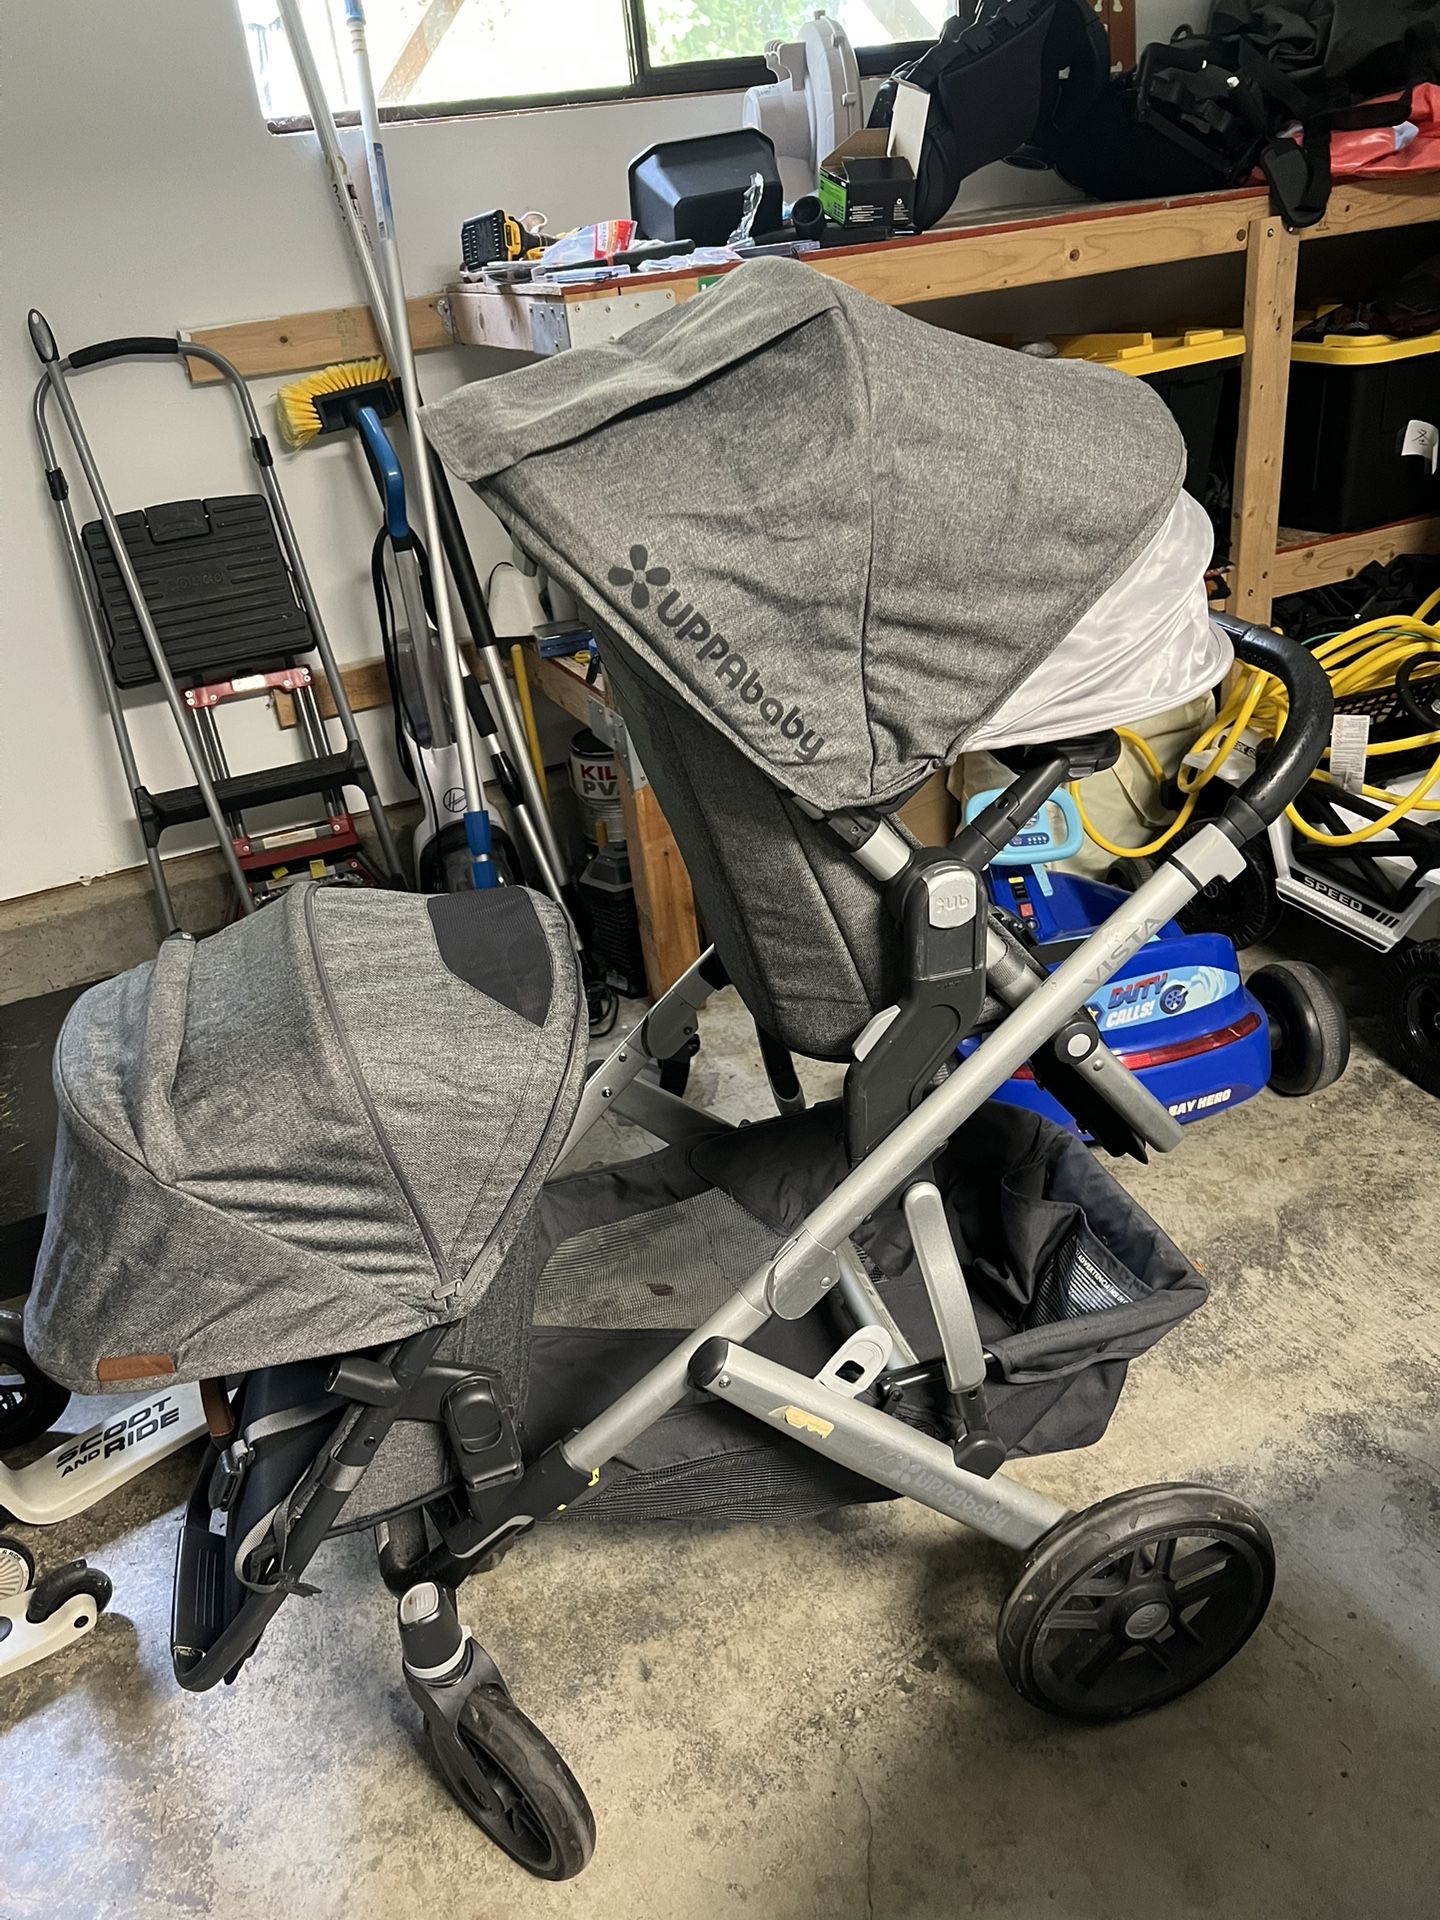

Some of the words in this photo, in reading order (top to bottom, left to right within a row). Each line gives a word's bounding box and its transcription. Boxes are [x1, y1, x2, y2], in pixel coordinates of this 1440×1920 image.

[657, 590, 825, 761] UPPAbaby
[1303, 876, 1363, 912] SPEED
[1082, 917, 1163, 986] VISTA
[1105, 1000, 1156, 1028] CALLS!
[1108, 972, 1169, 1010] DUTY
[1197, 1088, 1232, 1109] HERO
[56, 1396, 172, 1469] SCOOT
[61, 1449, 101, 1478] AND
[103, 1407, 180, 1460] RIDE
[915, 1470, 1010, 1529] UPPAbaby
